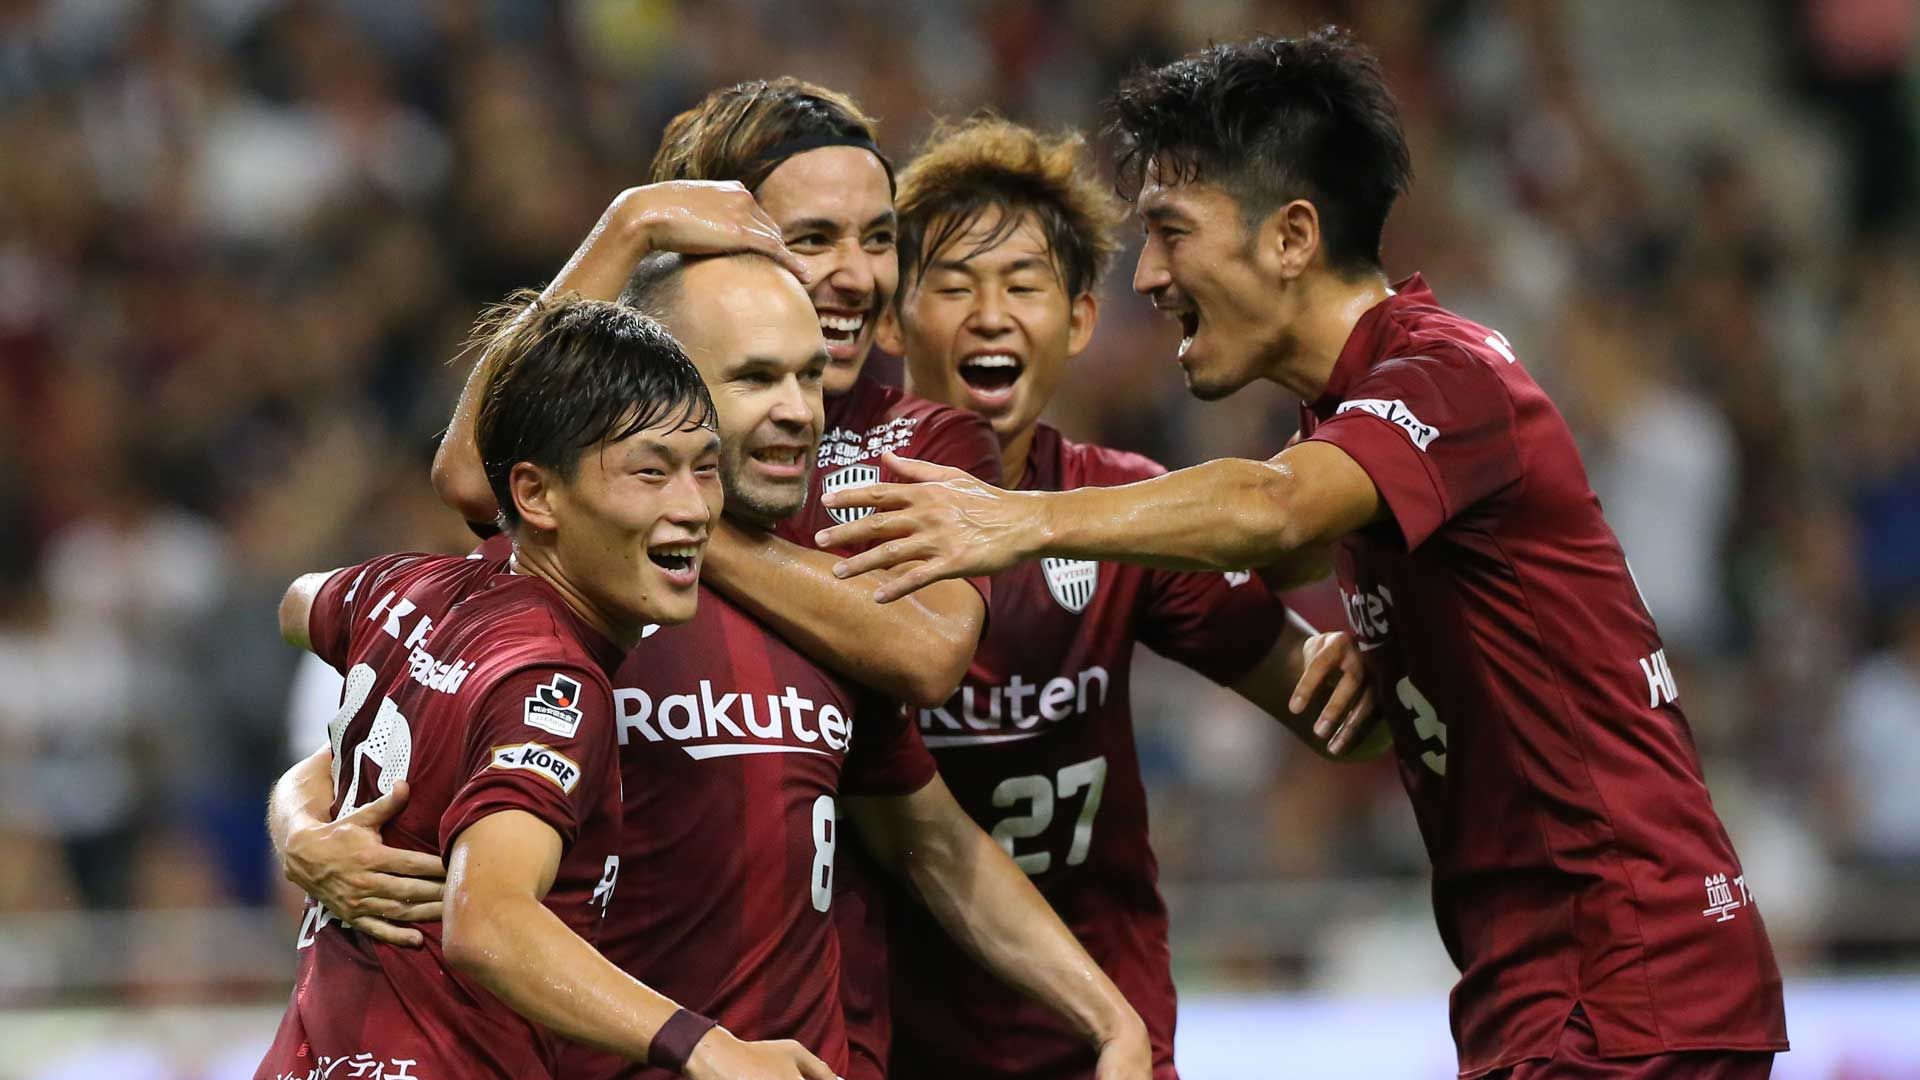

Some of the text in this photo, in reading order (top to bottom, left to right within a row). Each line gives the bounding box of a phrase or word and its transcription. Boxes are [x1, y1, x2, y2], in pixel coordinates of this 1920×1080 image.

[520, 748, 575, 787] KOBE
[992, 756, 1107, 875] 27
[811, 794, 836, 913] 8
